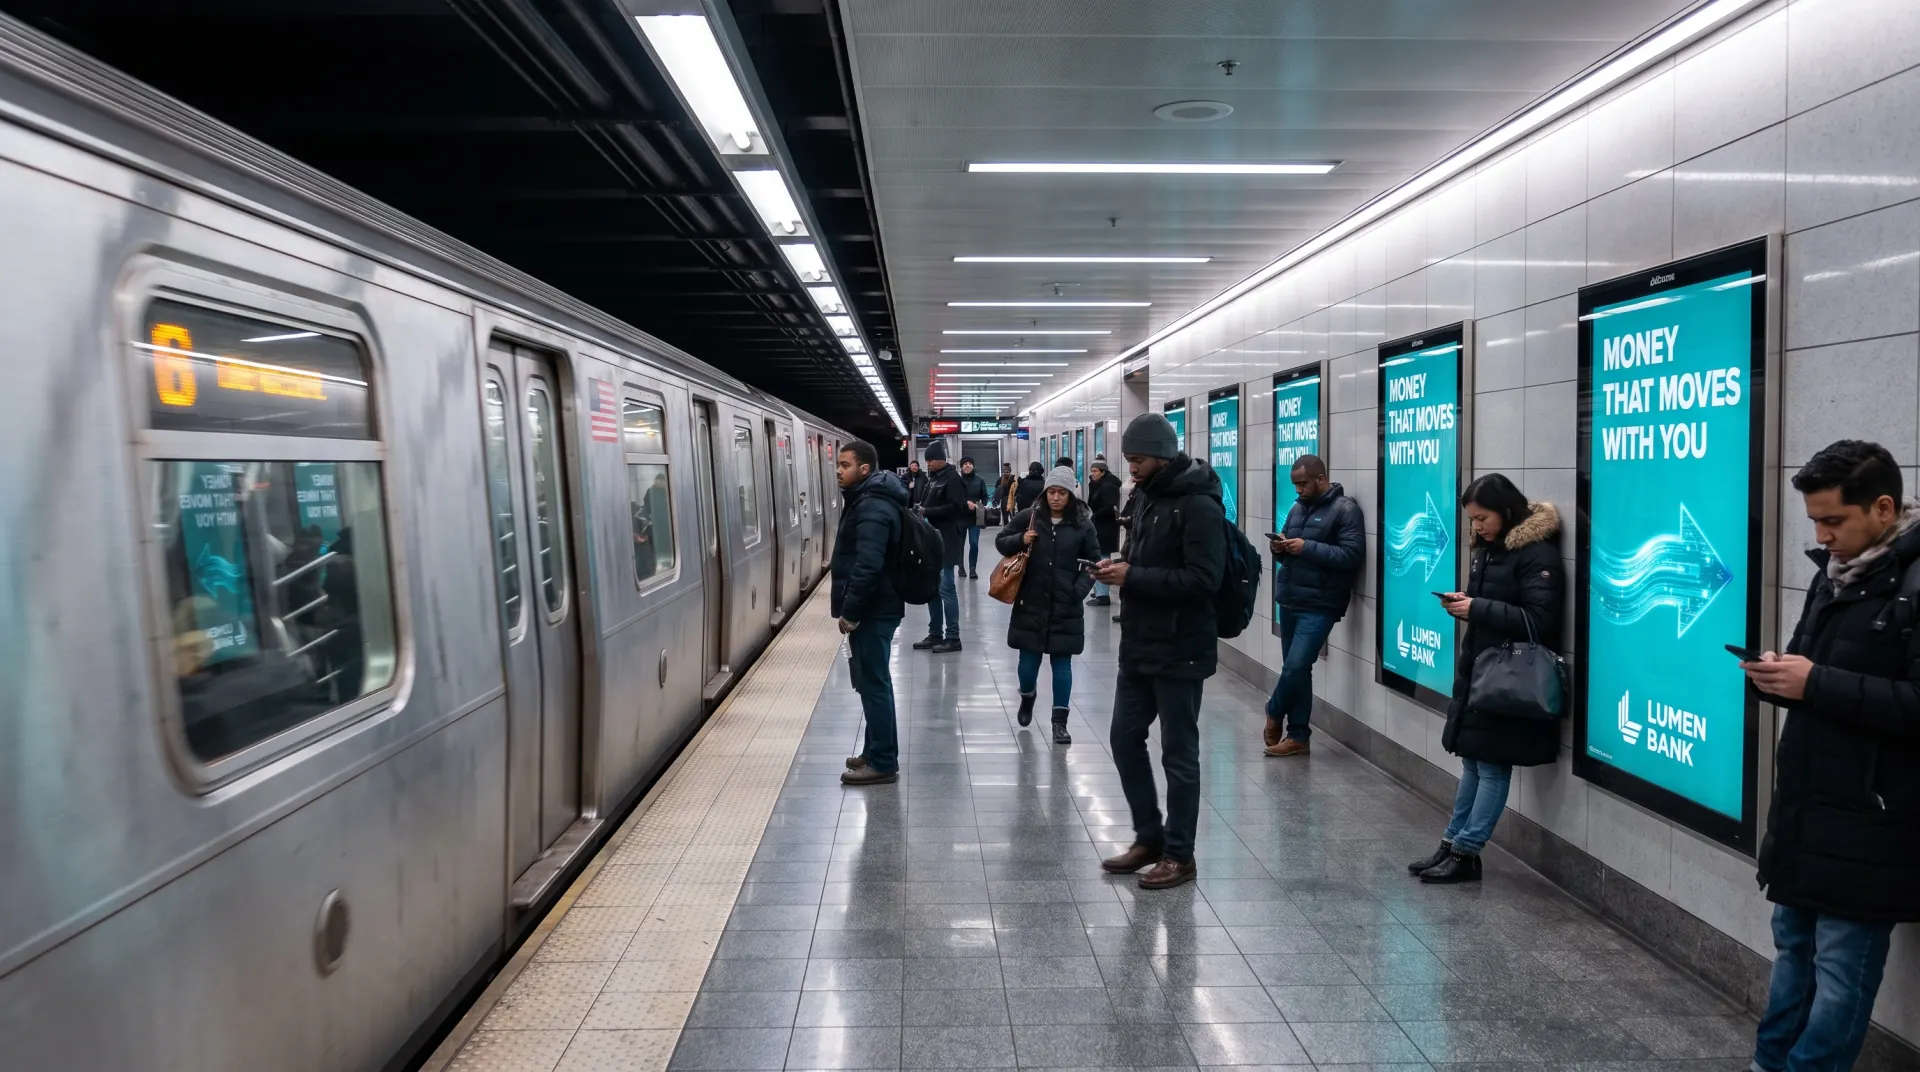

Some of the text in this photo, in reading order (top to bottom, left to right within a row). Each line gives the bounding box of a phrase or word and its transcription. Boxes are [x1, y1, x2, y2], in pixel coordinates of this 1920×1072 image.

[1603, 325, 1680, 371] MONEY
[1389, 373, 1427, 403] MONEY
[1602, 366, 1742, 416] THAT MOVES
[1279, 396, 1302, 418] MONEY
[1388, 403, 1454, 434] THAT MOVES
[1279, 419, 1317, 442] THAT MOVES
[1602, 421, 1708, 461] WITH YOU
[1279, 447, 1295, 466] WITH
[1388, 438, 1440, 465] WITH YOU
[1411, 624, 1441, 650] LUMEN
[1411, 644, 1436, 668] BANK
[1647, 699, 1707, 742] LUMEN
[1647, 727, 1694, 767] BANK
